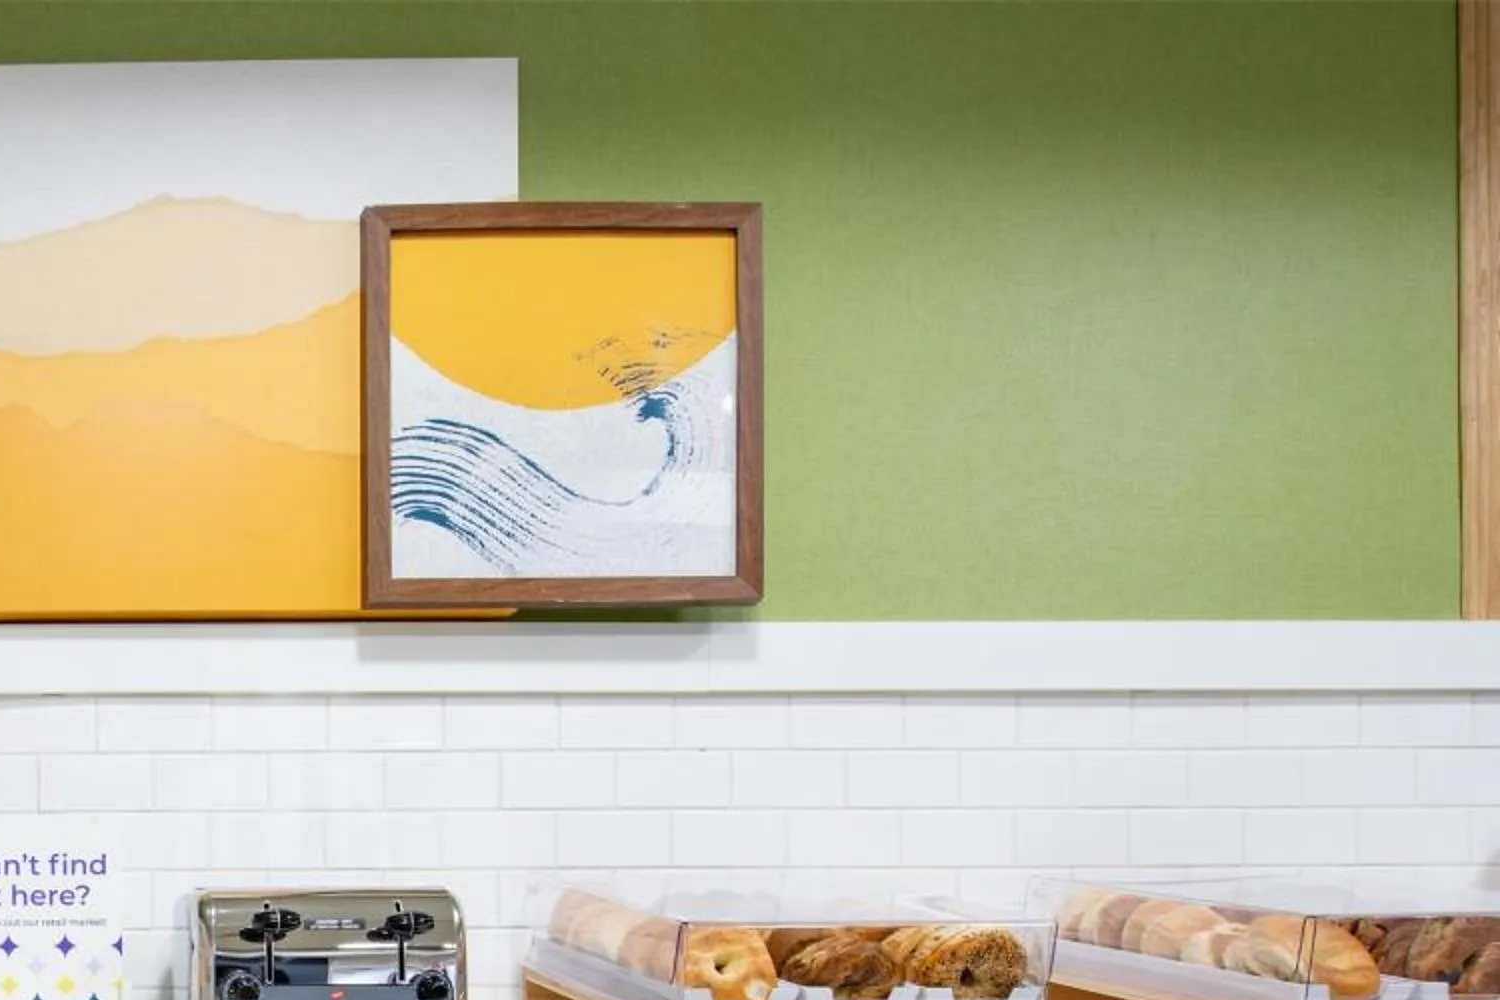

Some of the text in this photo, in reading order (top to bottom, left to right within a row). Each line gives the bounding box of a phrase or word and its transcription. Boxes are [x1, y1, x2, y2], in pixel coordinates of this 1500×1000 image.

[49, 853, 108, 876] find
[11, 883, 91, 906] here?
[41, 917, 67, 927] retail
